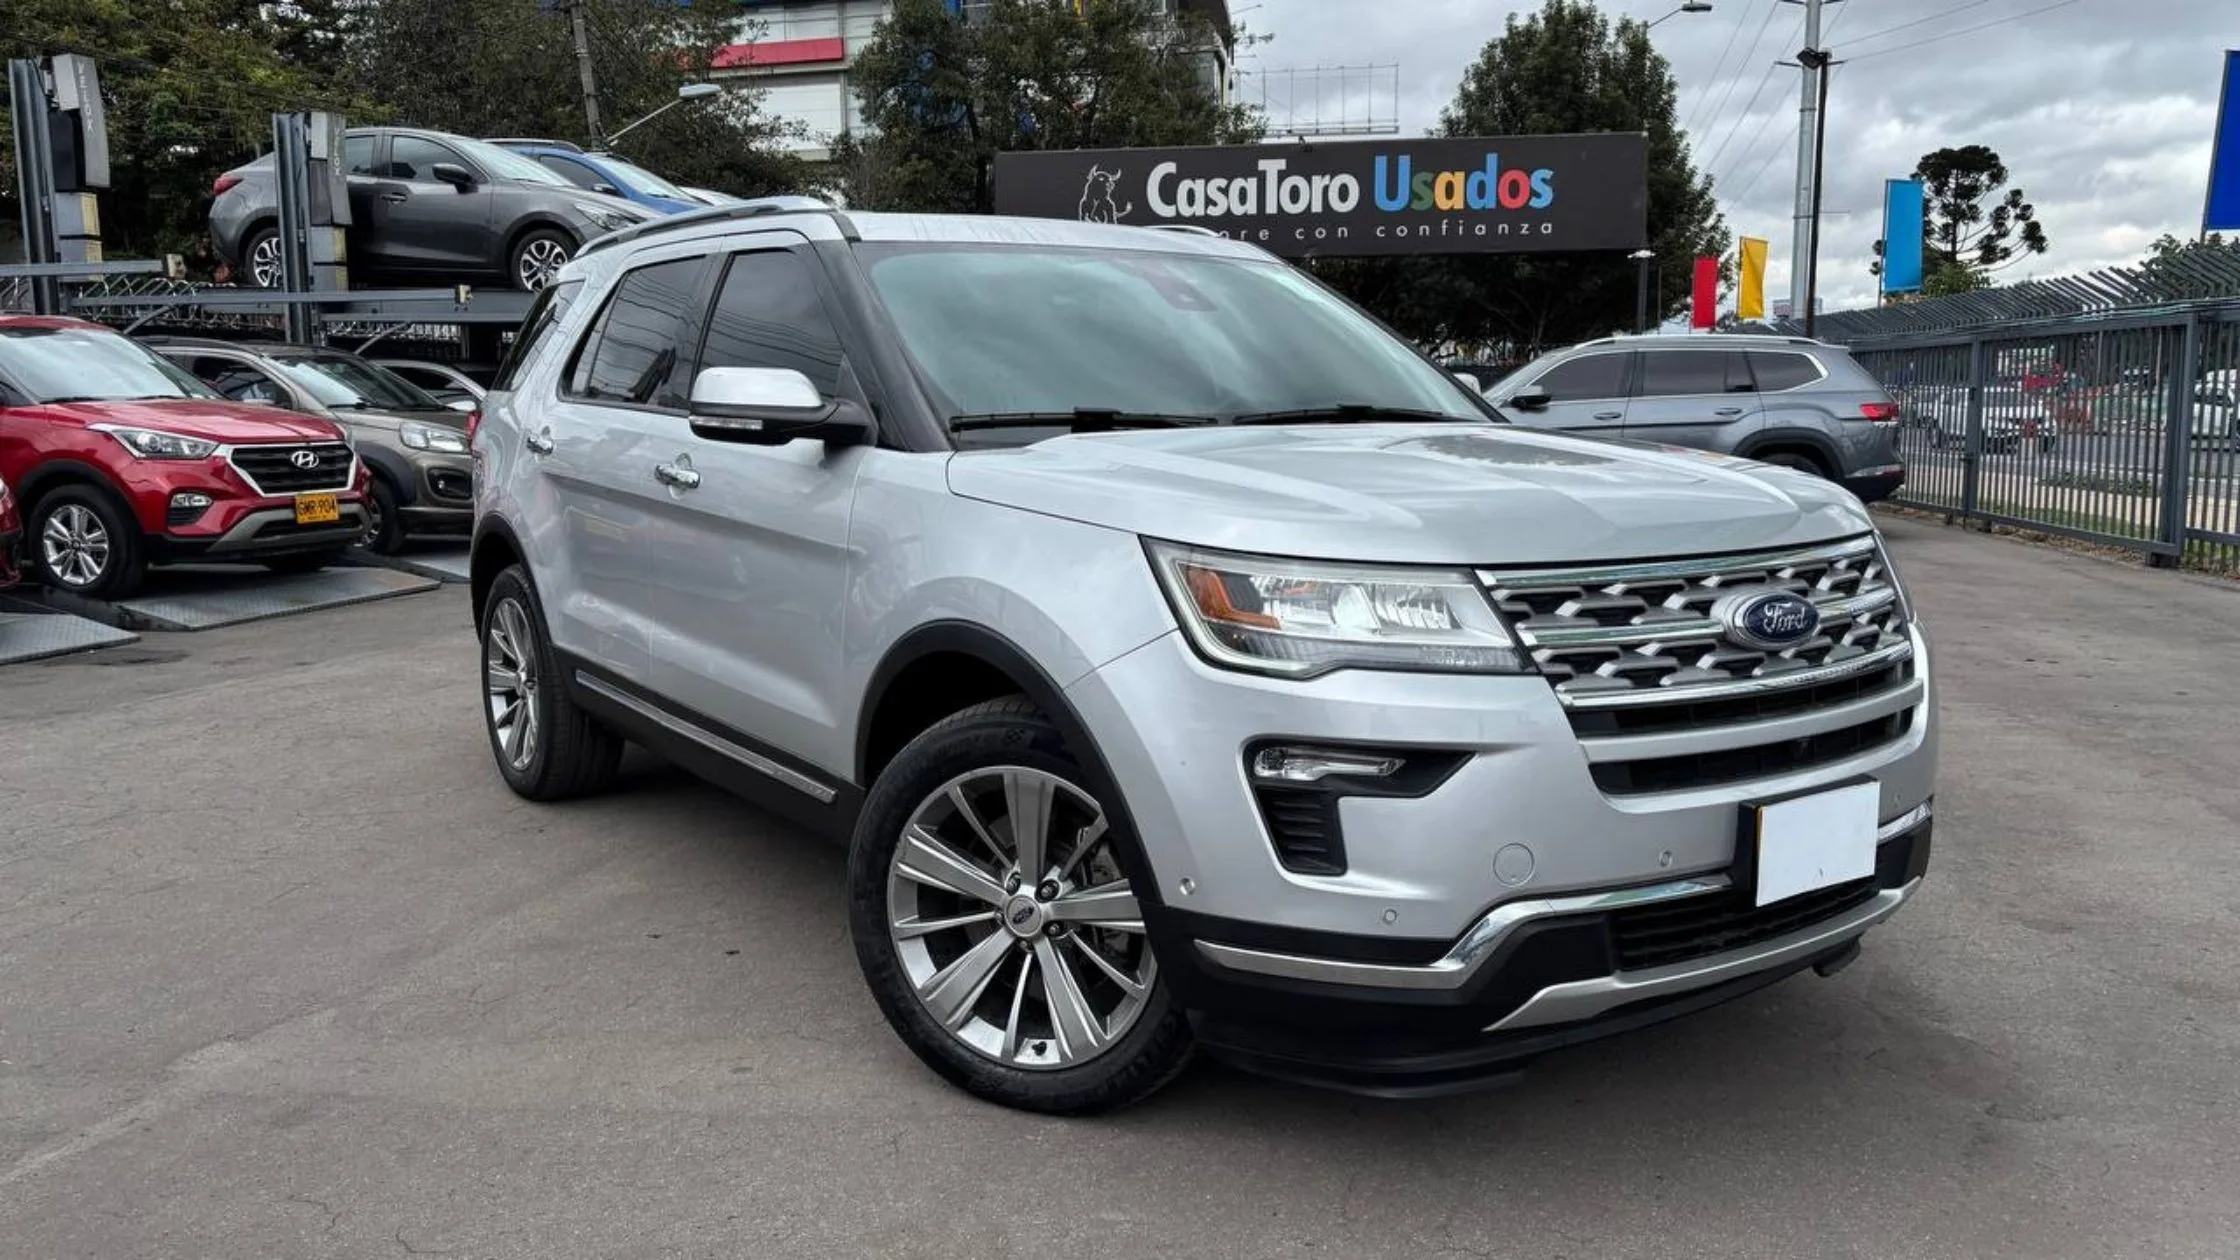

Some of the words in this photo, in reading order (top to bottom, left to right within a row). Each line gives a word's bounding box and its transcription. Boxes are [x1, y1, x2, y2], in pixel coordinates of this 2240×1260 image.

[1147, 159, 1360, 218] CasaToro
[1374, 152, 1555, 212] Usados
[1295, 226, 1349, 240] con
[1376, 218, 1553, 239] confianza
[1763, 601, 1807, 633] Ford
